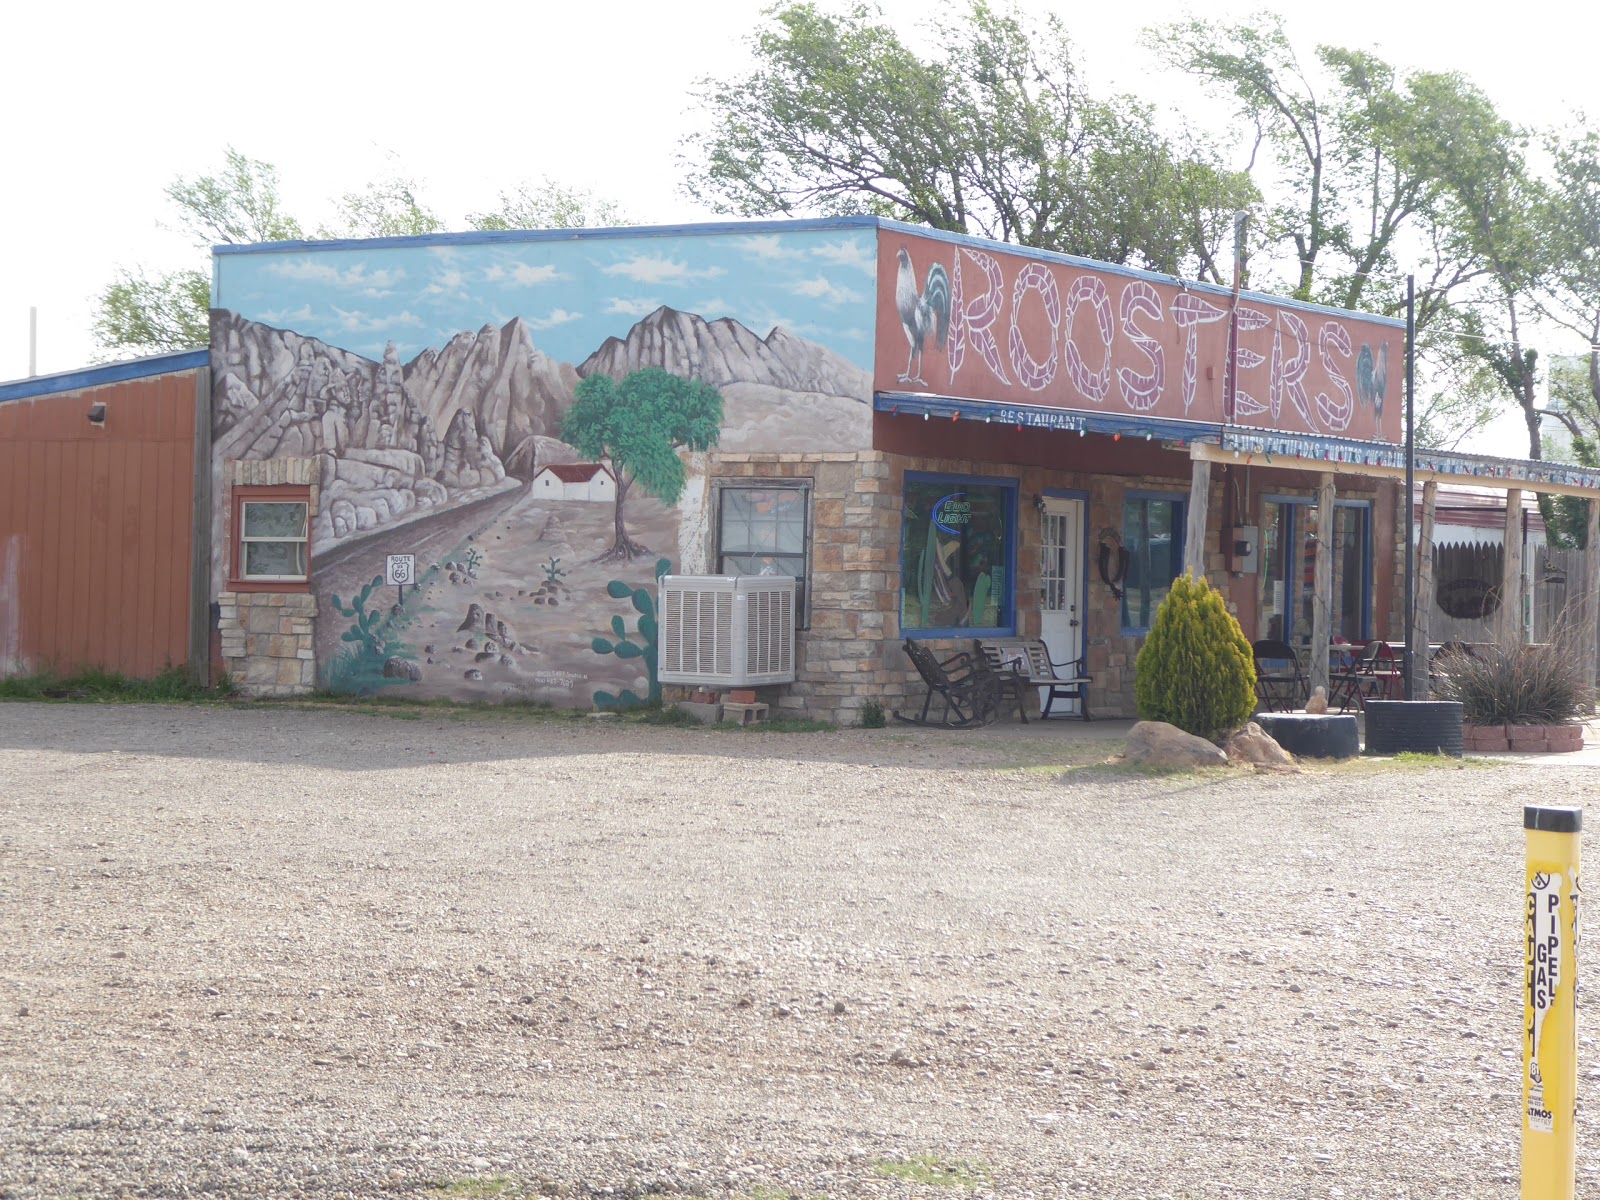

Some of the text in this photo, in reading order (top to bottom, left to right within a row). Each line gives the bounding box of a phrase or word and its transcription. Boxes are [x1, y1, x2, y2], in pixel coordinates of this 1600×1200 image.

[947, 245, 1354, 433] ROOSTERS
[999, 409, 1087, 431] RESTAURANT
[944, 500, 971, 512] BUD
[937, 511, 972, 524] LIGHT
[394, 569, 406, 579] 66
[1547, 893, 1560, 1006] PIPEL
[1537, 942, 1547, 1009] GAS
[1526, 1107, 1552, 1119] ATMOS
[1530, 1115, 1552, 1126] energy
